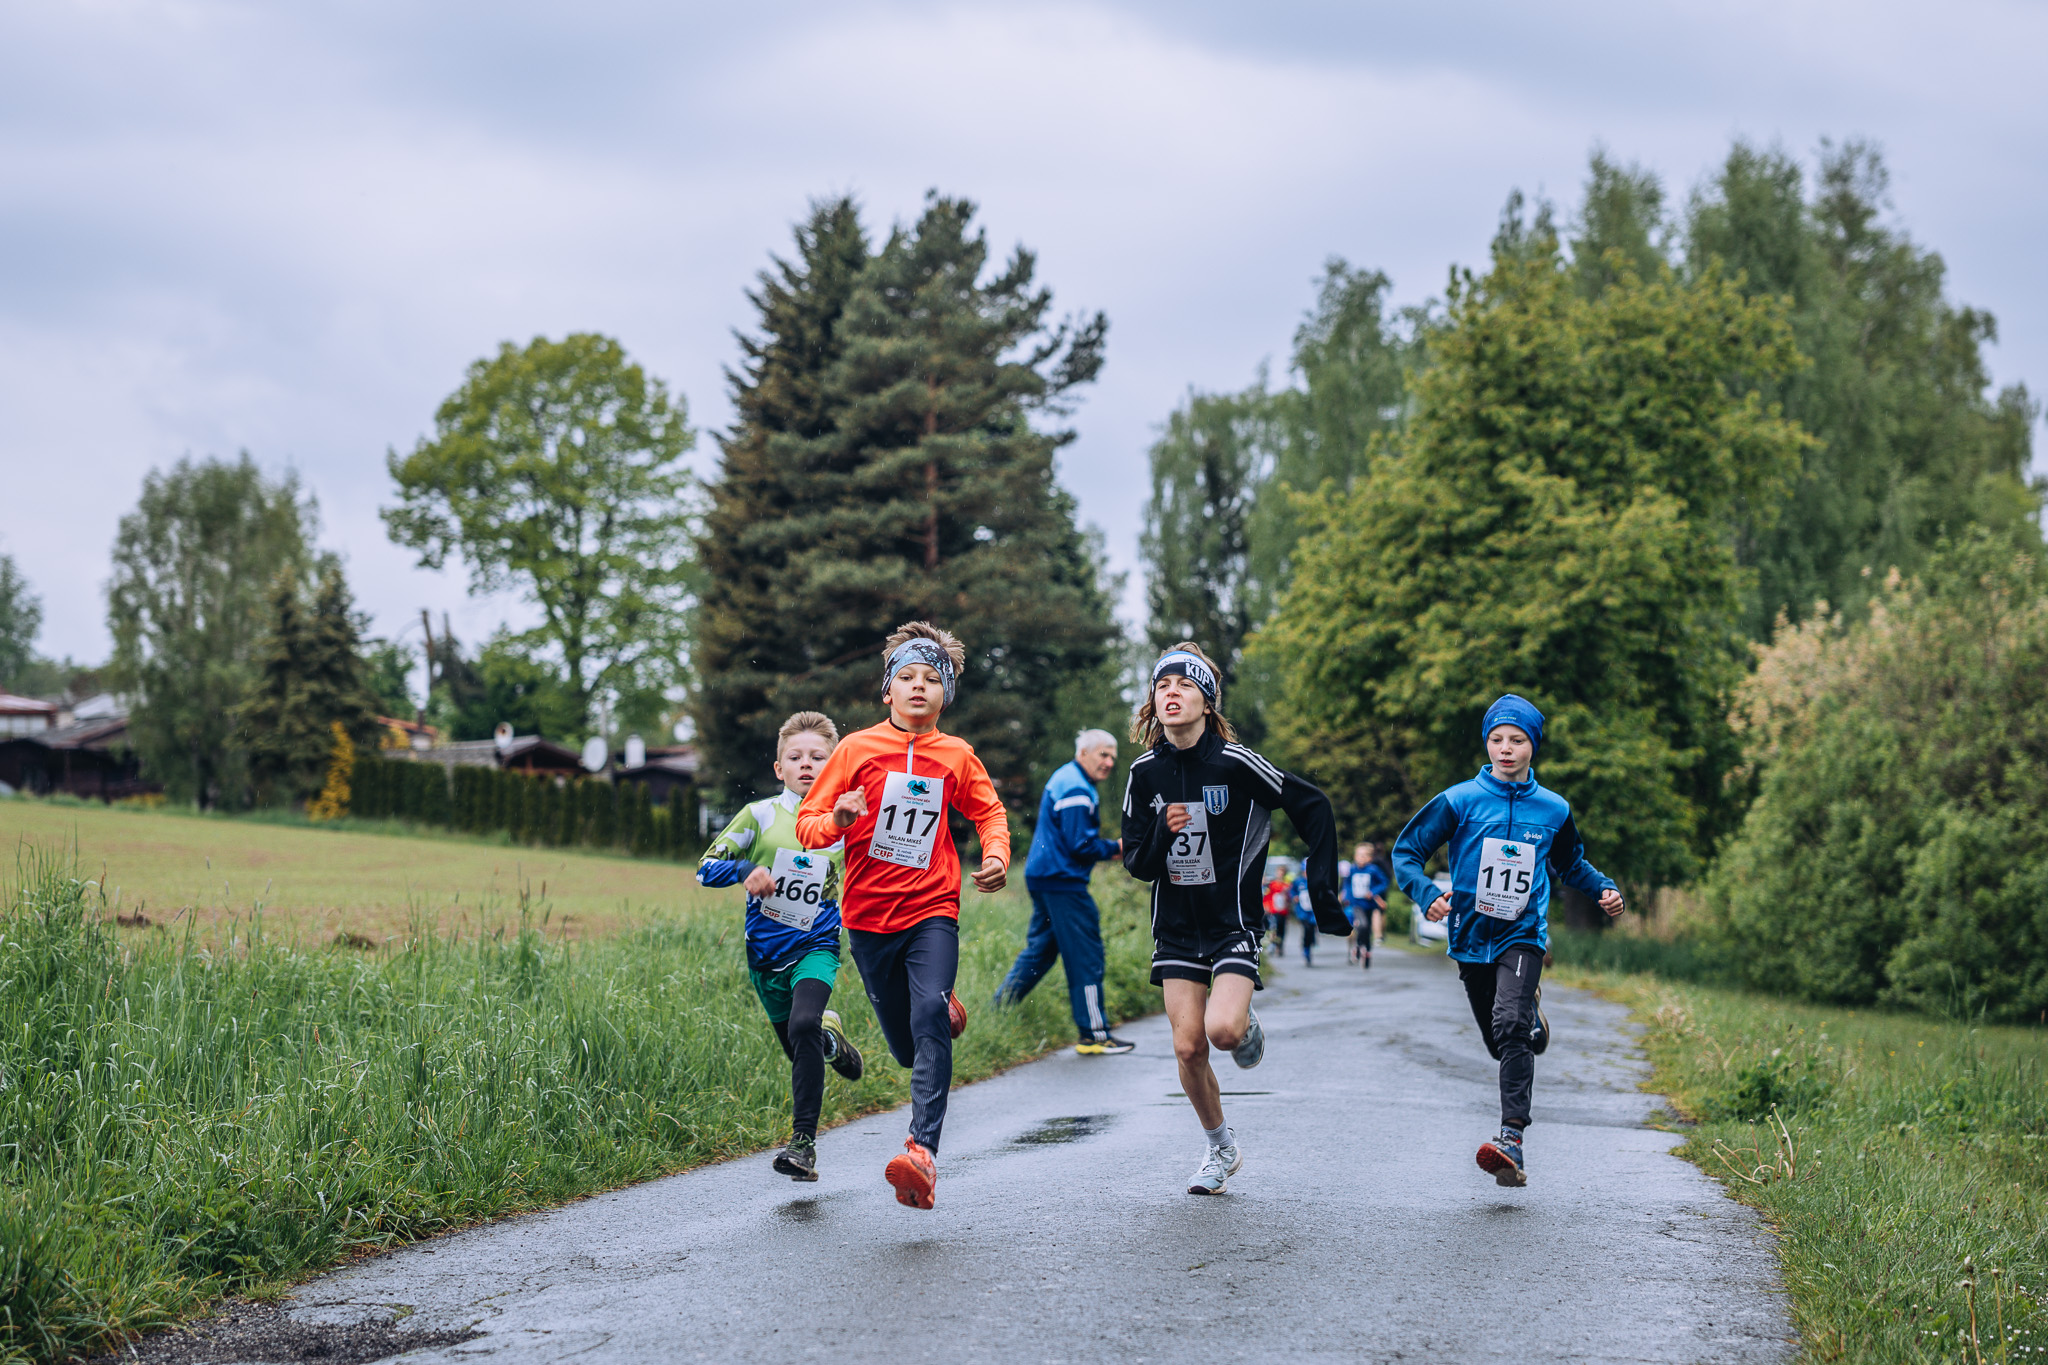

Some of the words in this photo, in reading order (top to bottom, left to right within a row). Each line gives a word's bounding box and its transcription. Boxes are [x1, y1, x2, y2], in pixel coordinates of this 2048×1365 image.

[883, 804, 939, 837] 117
[888, 834, 905, 842] MILAN
[1169, 831, 1207, 856] 37
[873, 848, 893, 858] CUP
[1482, 866, 1530, 894] 115
[775, 876, 821, 905] 466
[764, 909, 780, 918] CUP
[1478, 904, 1494, 912] CUP
